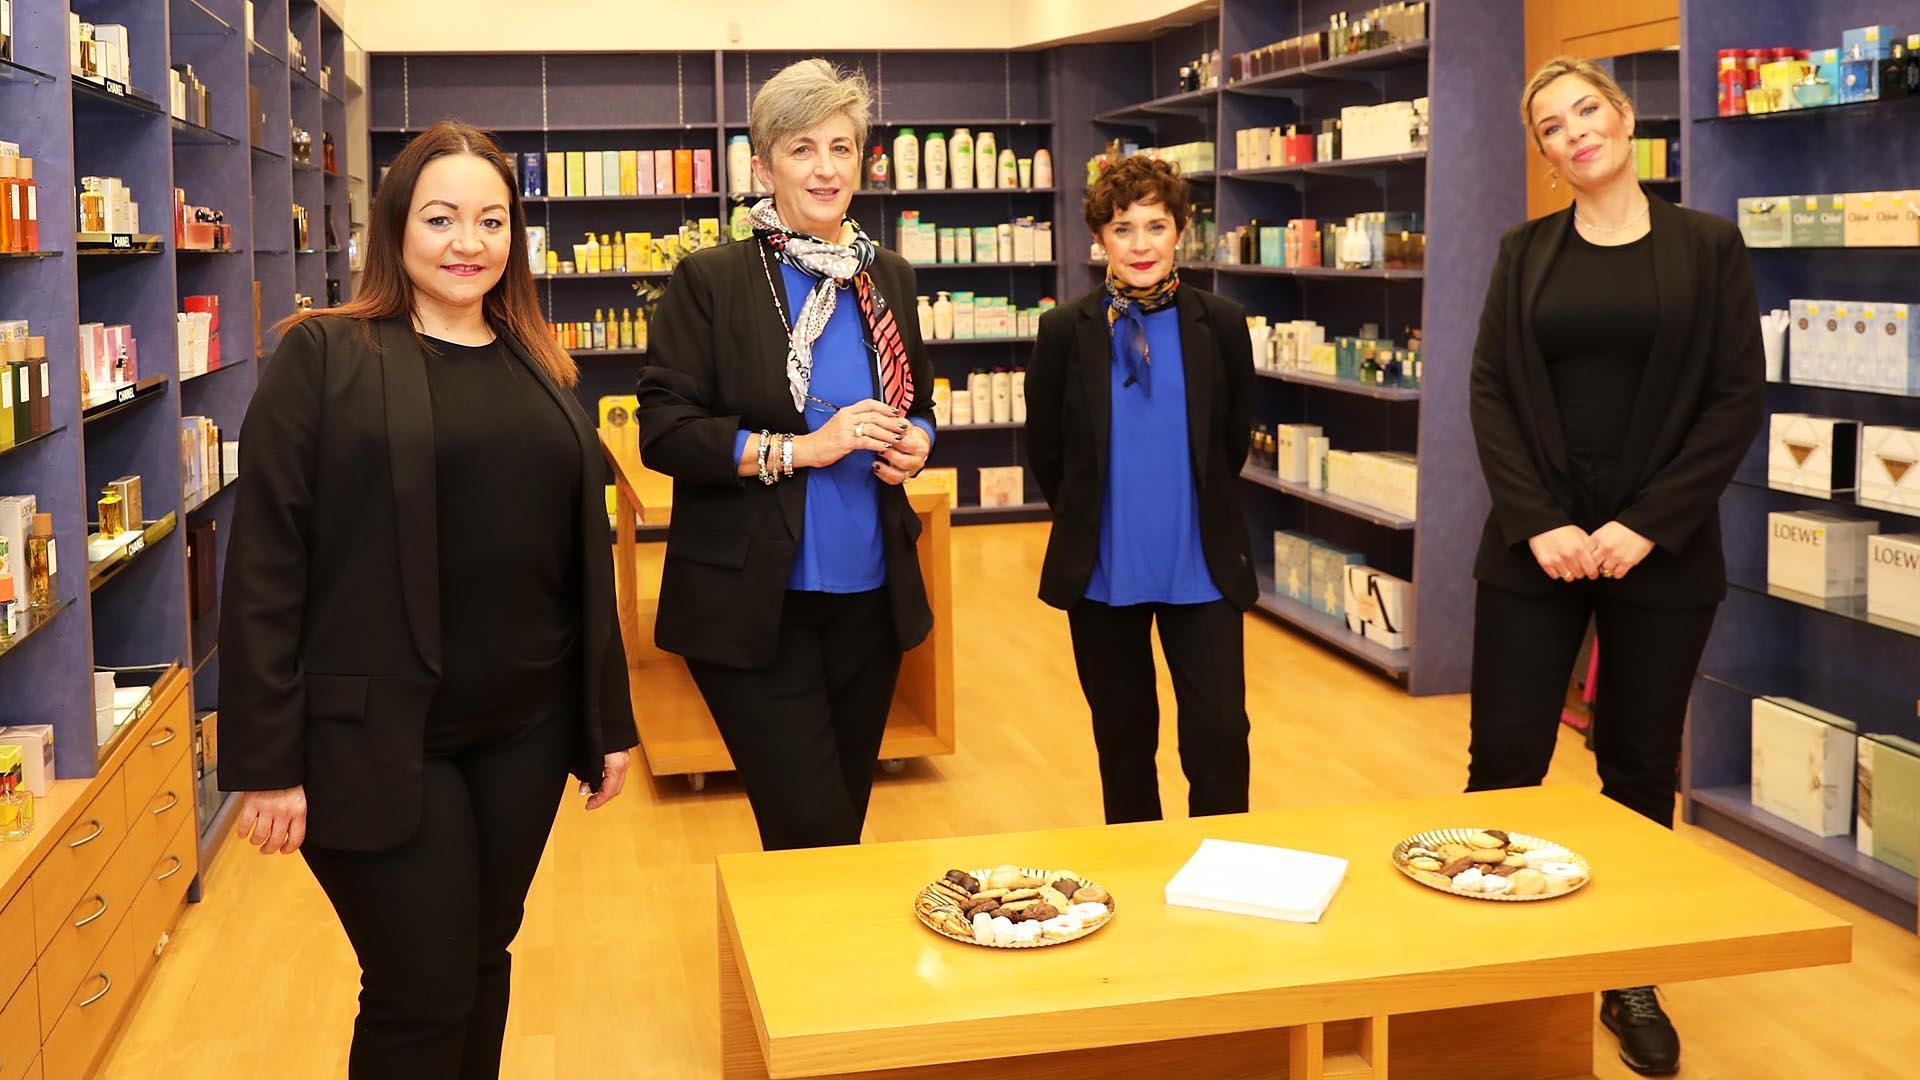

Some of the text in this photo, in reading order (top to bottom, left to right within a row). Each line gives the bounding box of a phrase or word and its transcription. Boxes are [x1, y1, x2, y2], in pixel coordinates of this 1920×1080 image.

[106, 80, 124, 96] CHANEL
[114, 236, 130, 247] CHANEL
[118, 387, 135, 402] CHANEL
[1774, 523, 1819, 546] LOEWE
[128, 536, 145, 556] CHANEL
